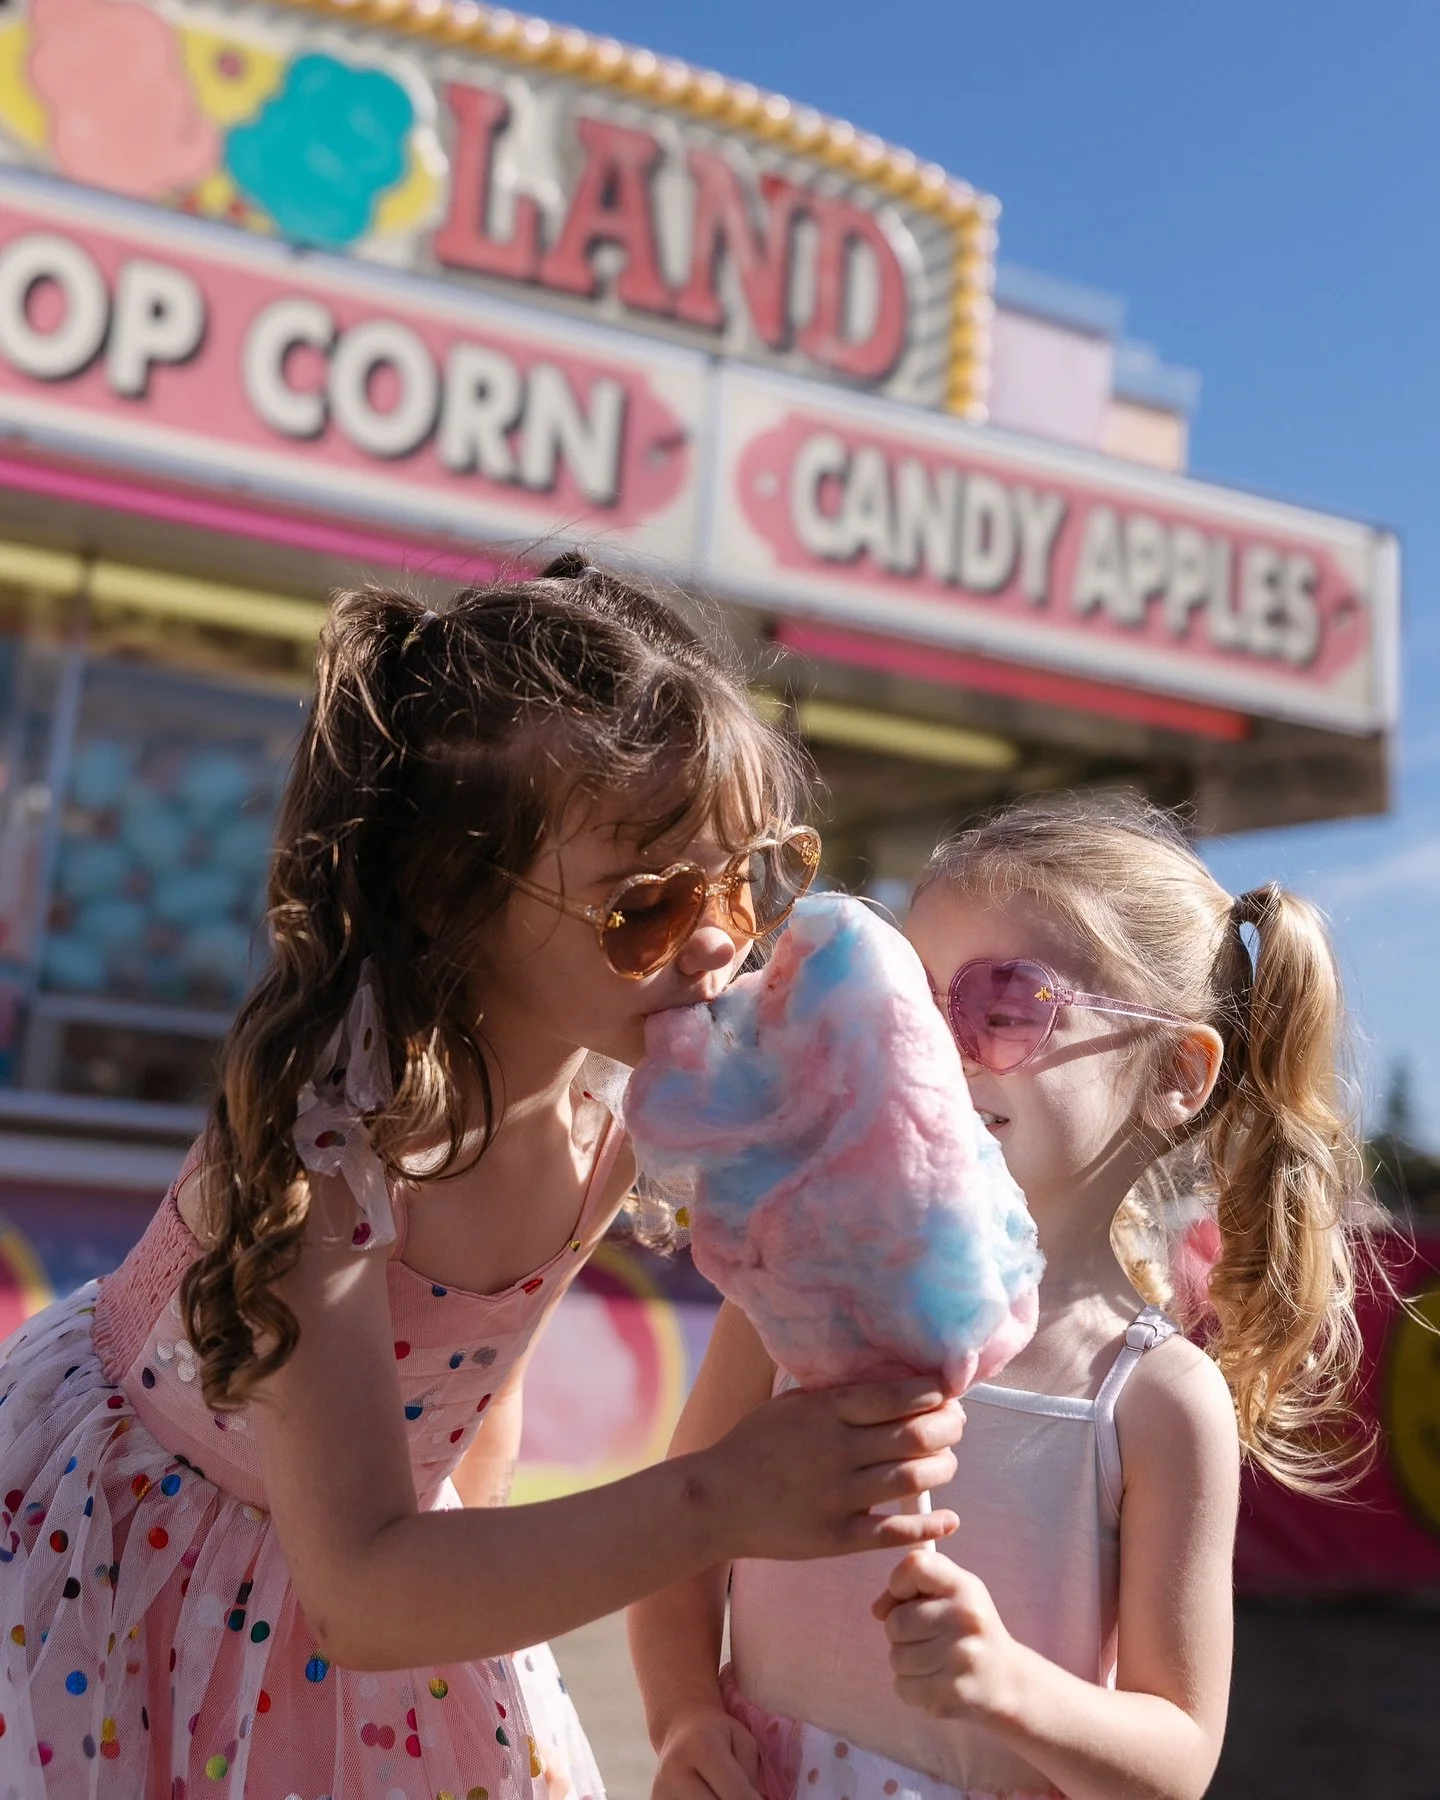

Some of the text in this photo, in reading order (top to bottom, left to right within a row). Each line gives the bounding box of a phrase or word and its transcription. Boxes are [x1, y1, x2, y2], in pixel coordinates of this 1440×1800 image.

[434, 82, 908, 380] LAND
[0, 233, 627, 506] OP CORN
[792, 435, 1321, 668] CANDY APPLES
